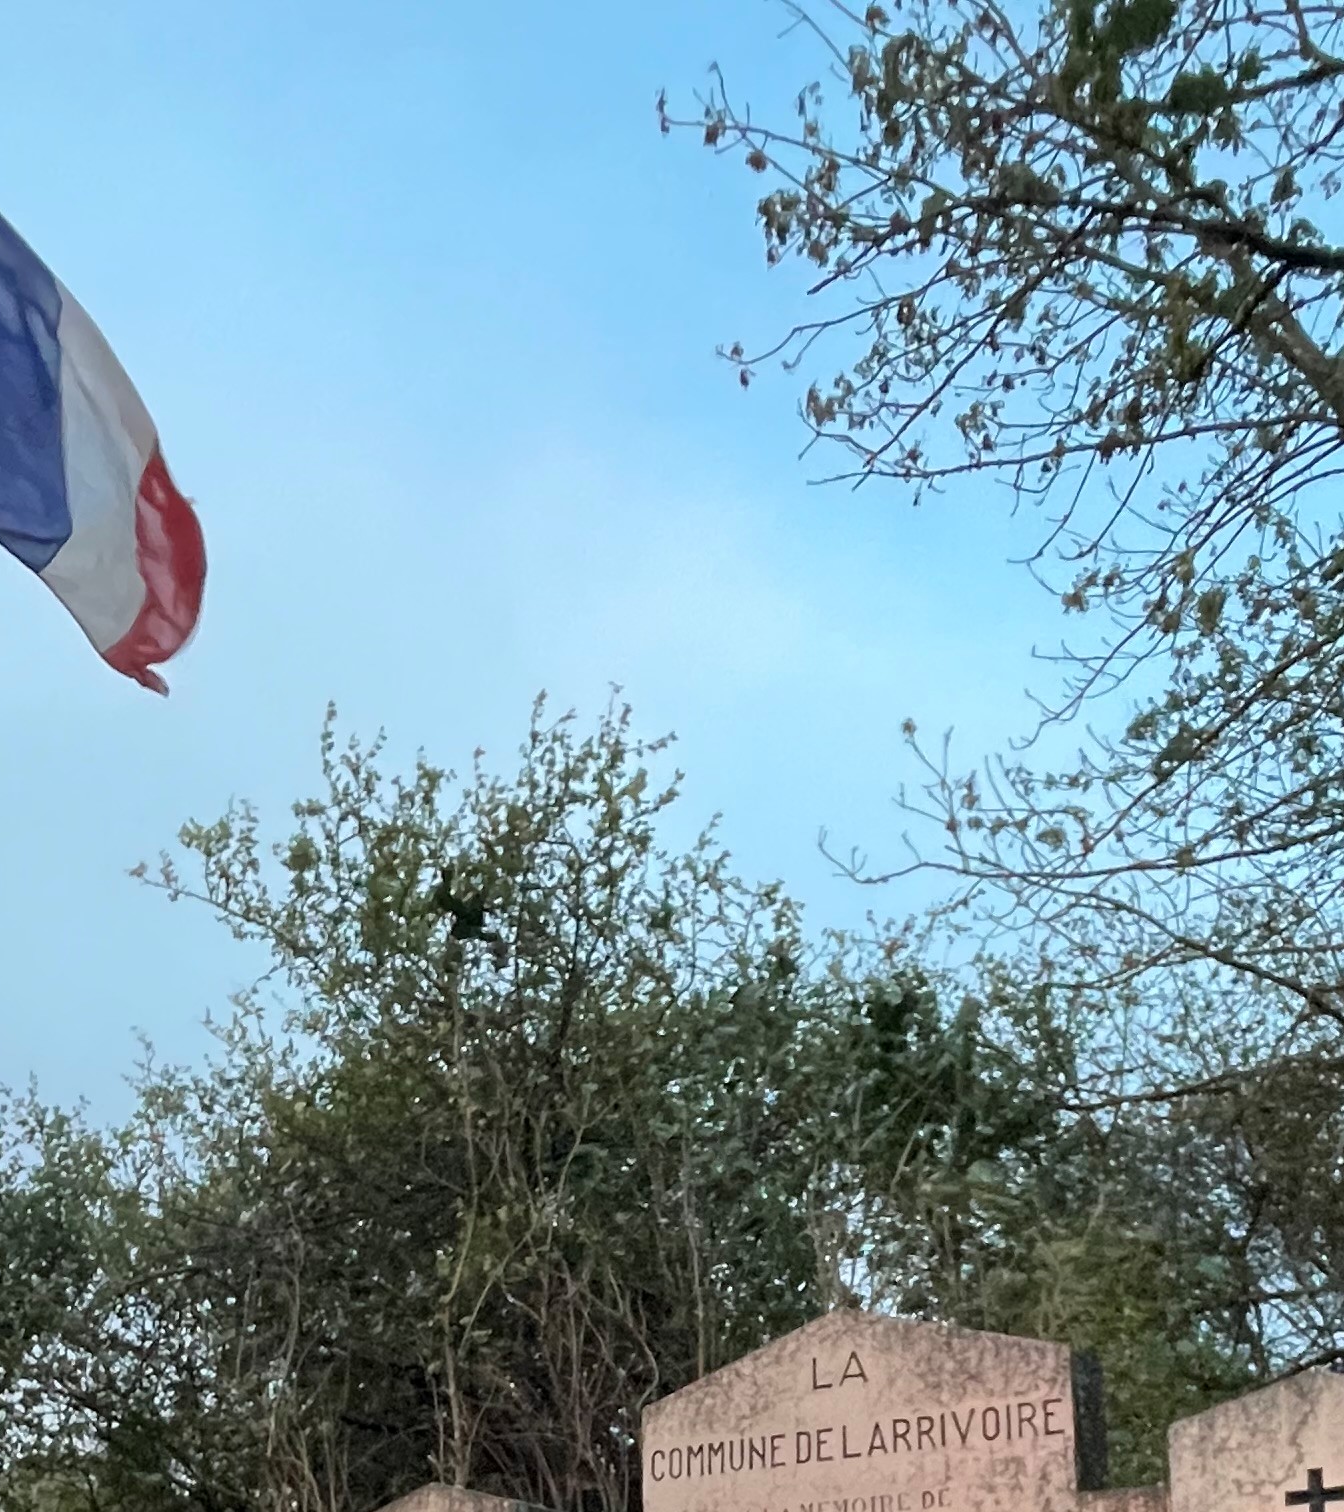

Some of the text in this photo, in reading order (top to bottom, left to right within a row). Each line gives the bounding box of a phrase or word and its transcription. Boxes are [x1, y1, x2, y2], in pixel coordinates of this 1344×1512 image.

[813, 1351, 869, 1390] LA
[651, 1398, 1065, 1481] COMMUNE DE LARRIVOIRE
[921, 1487, 952, 1510] DE
